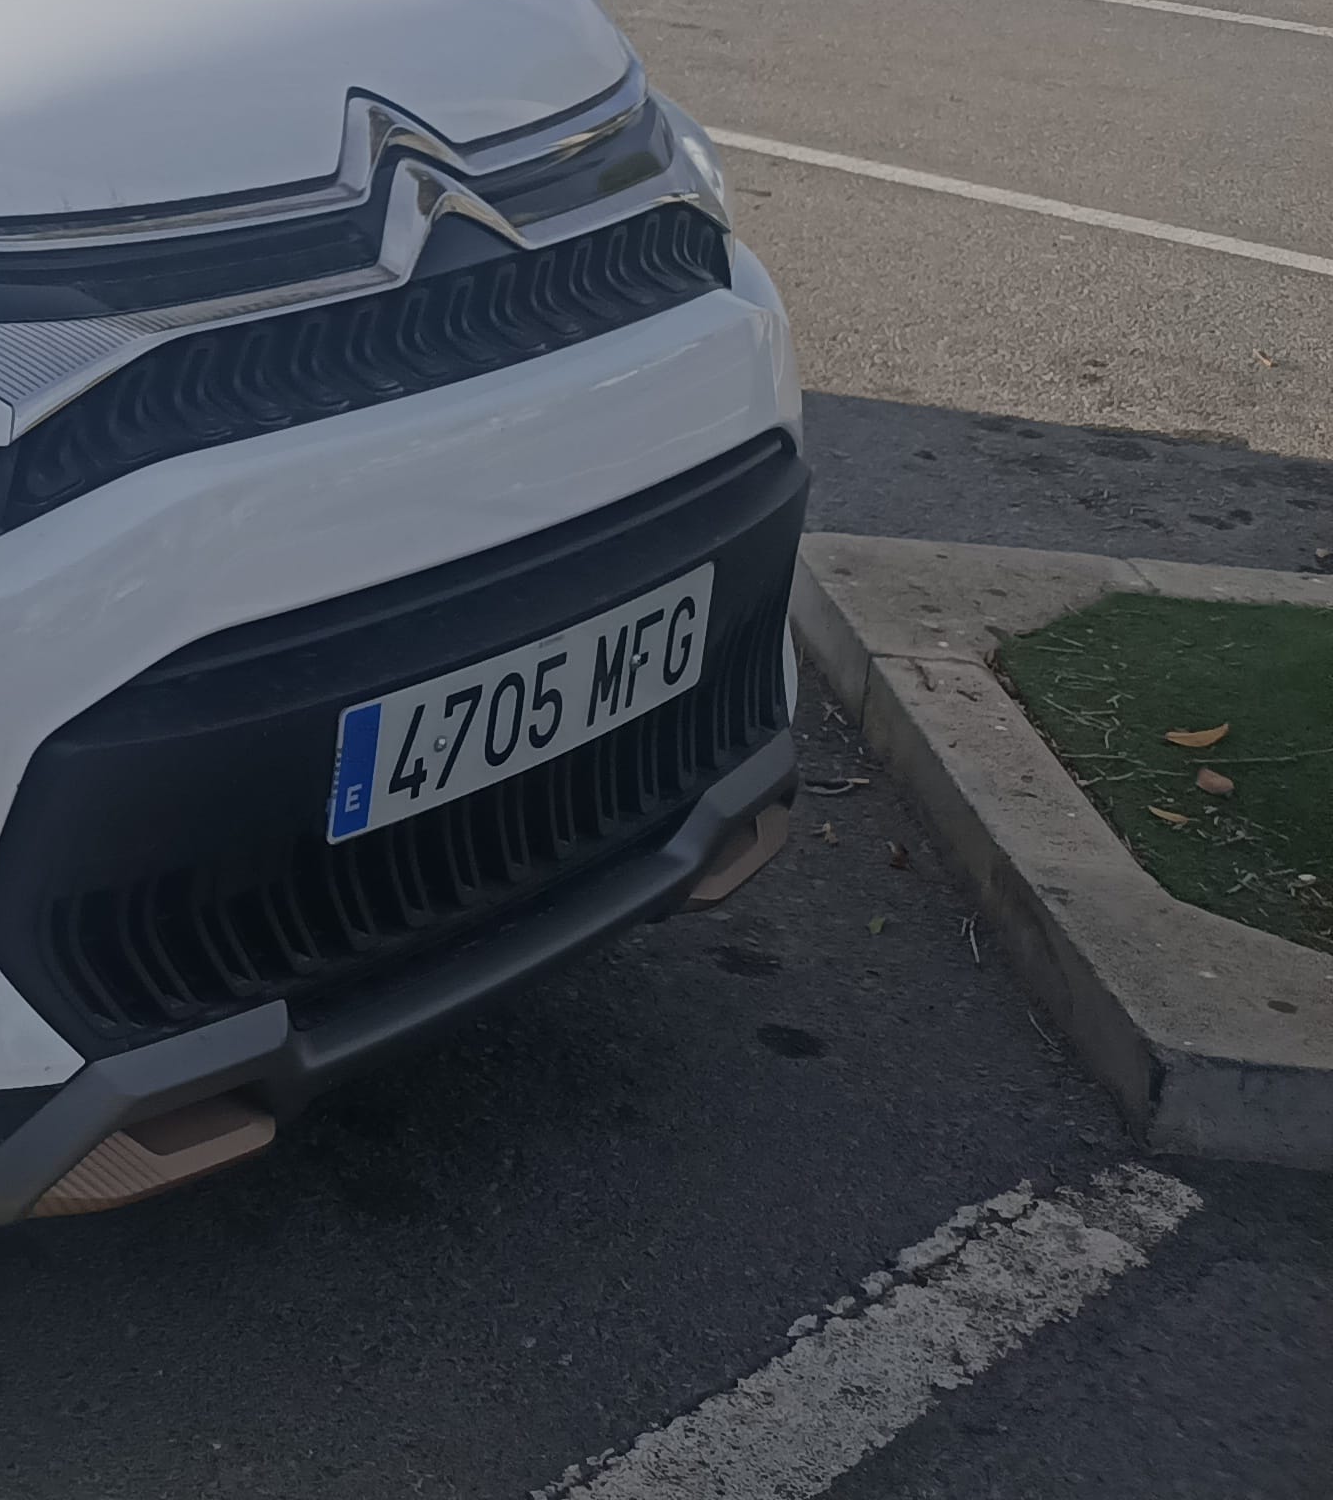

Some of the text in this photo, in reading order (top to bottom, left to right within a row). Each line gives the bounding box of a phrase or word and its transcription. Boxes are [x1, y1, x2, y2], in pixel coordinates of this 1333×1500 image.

[344, 596, 696, 812] E 4705 MFG
